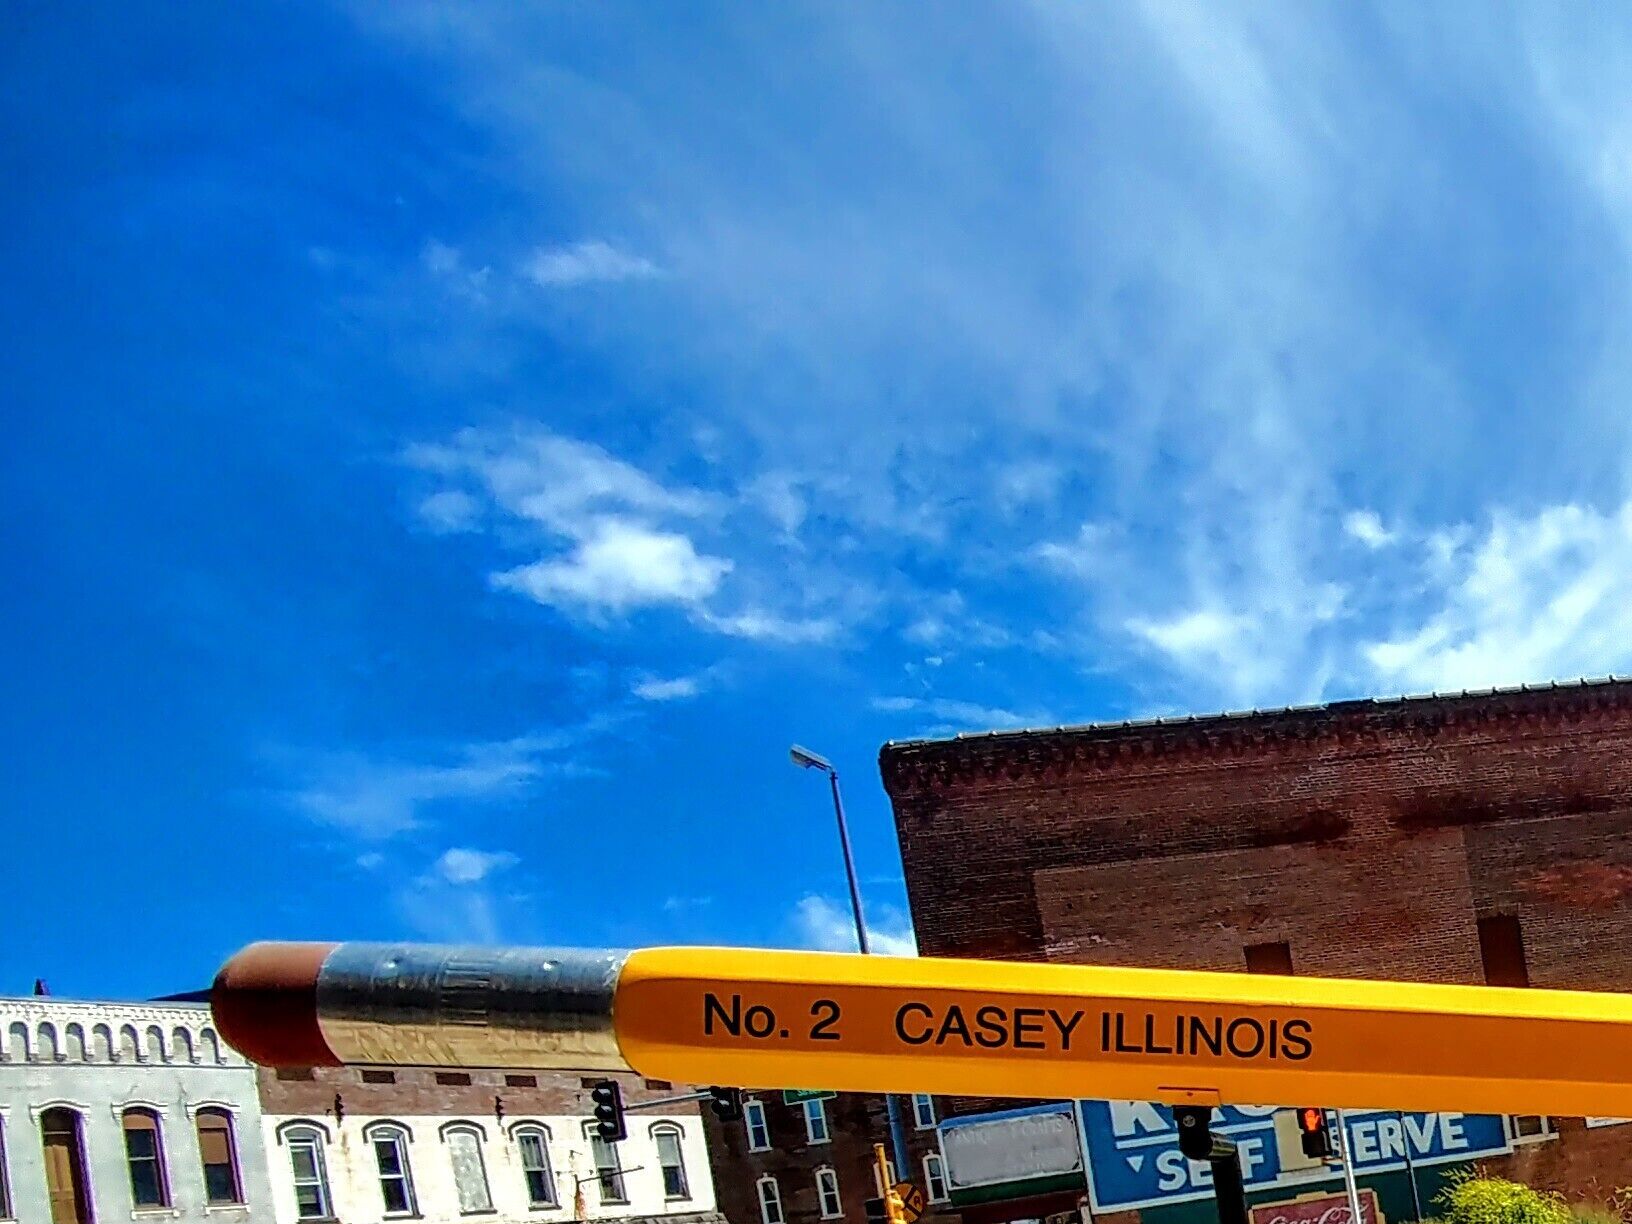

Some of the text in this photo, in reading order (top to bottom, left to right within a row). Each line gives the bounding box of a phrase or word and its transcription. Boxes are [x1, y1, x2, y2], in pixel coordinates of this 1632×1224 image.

[704, 992, 1313, 1061] No. 2 CASEY ILLINOIS
[1156, 1138, 1265, 1191] SEF
